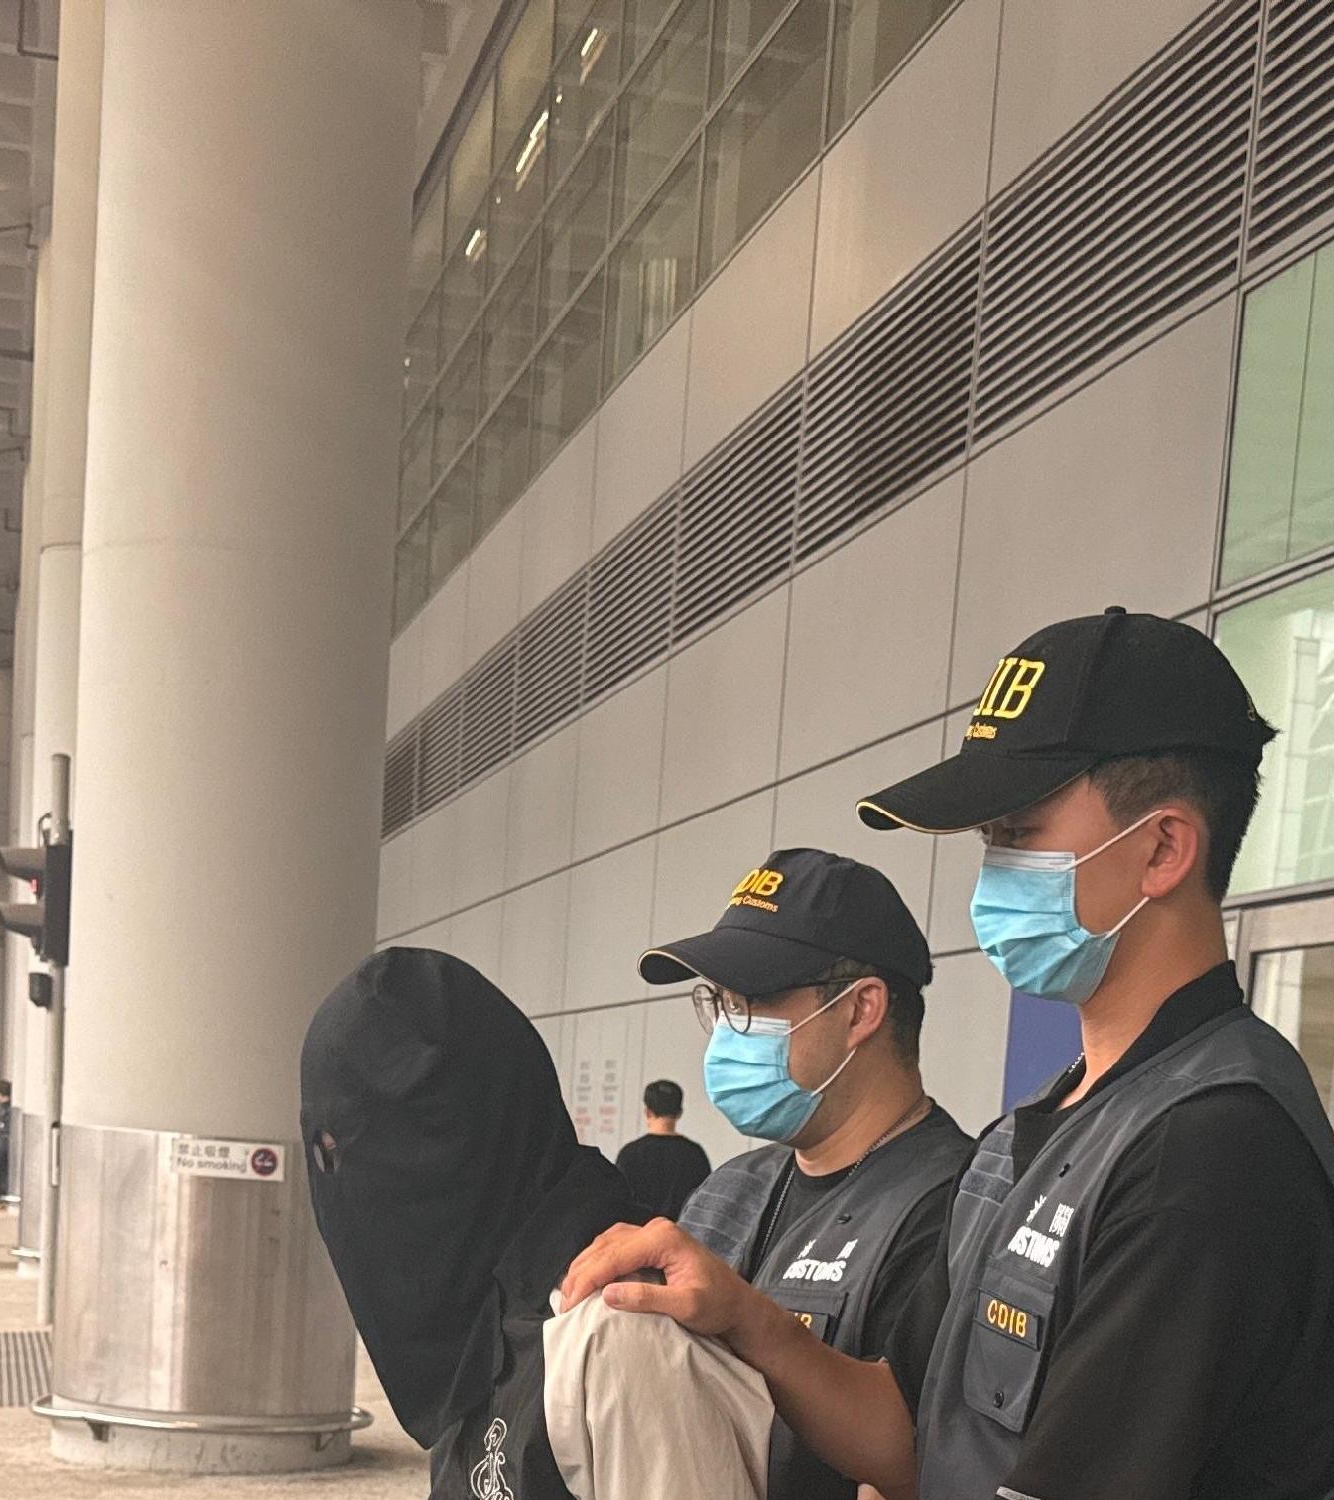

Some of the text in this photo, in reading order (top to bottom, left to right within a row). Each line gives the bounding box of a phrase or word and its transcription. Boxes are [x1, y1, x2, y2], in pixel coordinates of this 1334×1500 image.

[177, 1156, 248, 1175] No smoking
[987, 1299, 1027, 1338] CDIB
